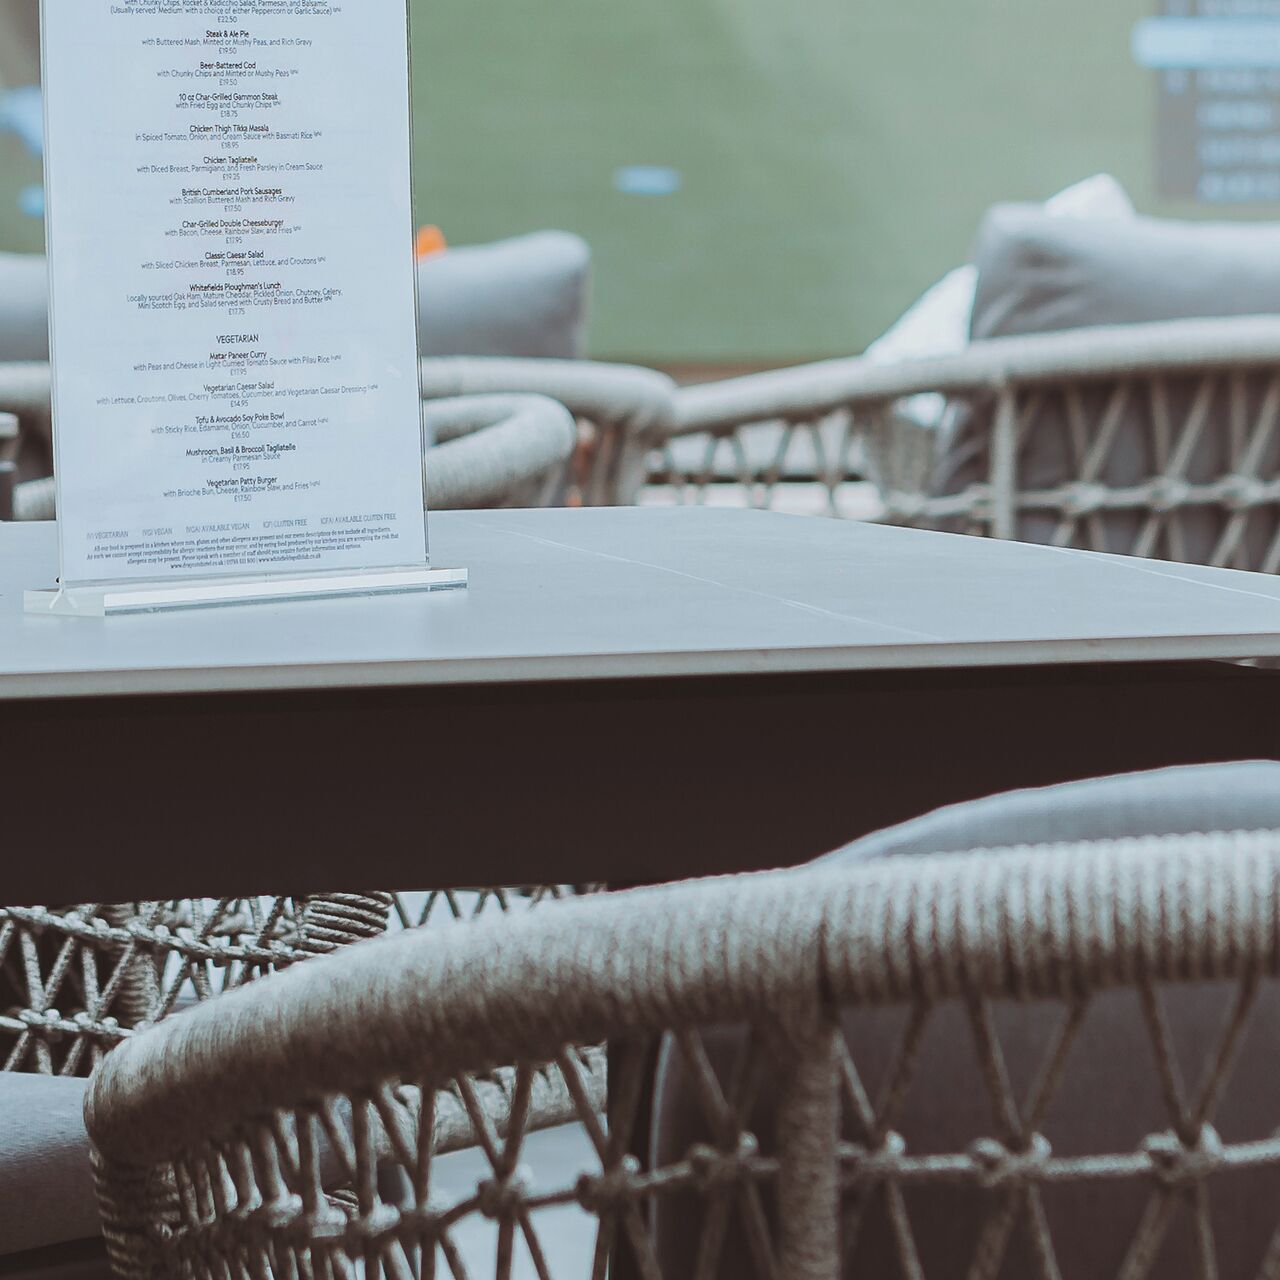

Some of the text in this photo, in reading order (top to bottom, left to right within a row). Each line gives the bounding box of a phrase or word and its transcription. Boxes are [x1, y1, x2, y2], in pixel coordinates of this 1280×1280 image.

[206, 30, 223, 38] Steak
[229, 30, 239, 38] Ale
[240, 30, 249, 38] Pie
[196, 93, 232, 101] Char-Grilled
[233, 93, 261, 101] Gammon
[262, 93, 278, 101] Steak
[215, 125, 232, 134] Thigh
[249, 124, 269, 132] Masala
[204, 156, 258, 165] Chicken Tagliatelle
[182, 188, 201, 196] British
[202, 188, 239, 196] Cumberland
[255, 187, 282, 197] Sausages
[182, 220, 219, 228] Char-Grilled
[242, 219, 284, 229] Cheeseburger
[227, 251, 247, 259] Caesar
[248, 251, 264, 259] Salad
[190, 282, 281, 292] Whitefields Ploughman's Lunch
[216, 335, 259, 344] VEGETARIAN
[228, 351, 249, 359] Paneer
[250, 351, 267, 360] Curry
[203, 382, 274, 394] Vegetarian Caesar Salad
[196, 416, 209, 424] Tofu
[216, 414, 242, 423] Avocado
[242, 414, 254, 424] Soy
[255, 413, 269, 421] Poke
[270, 413, 285, 421] Bowl
[186, 447, 219, 457] Mushroom,
[221, 446, 234, 455] Basil
[241, 445, 265, 454] Broccoli
[267, 443, 296, 454] Tagliatelle
[207, 476, 277, 489] Vegetarian Patty Burger
